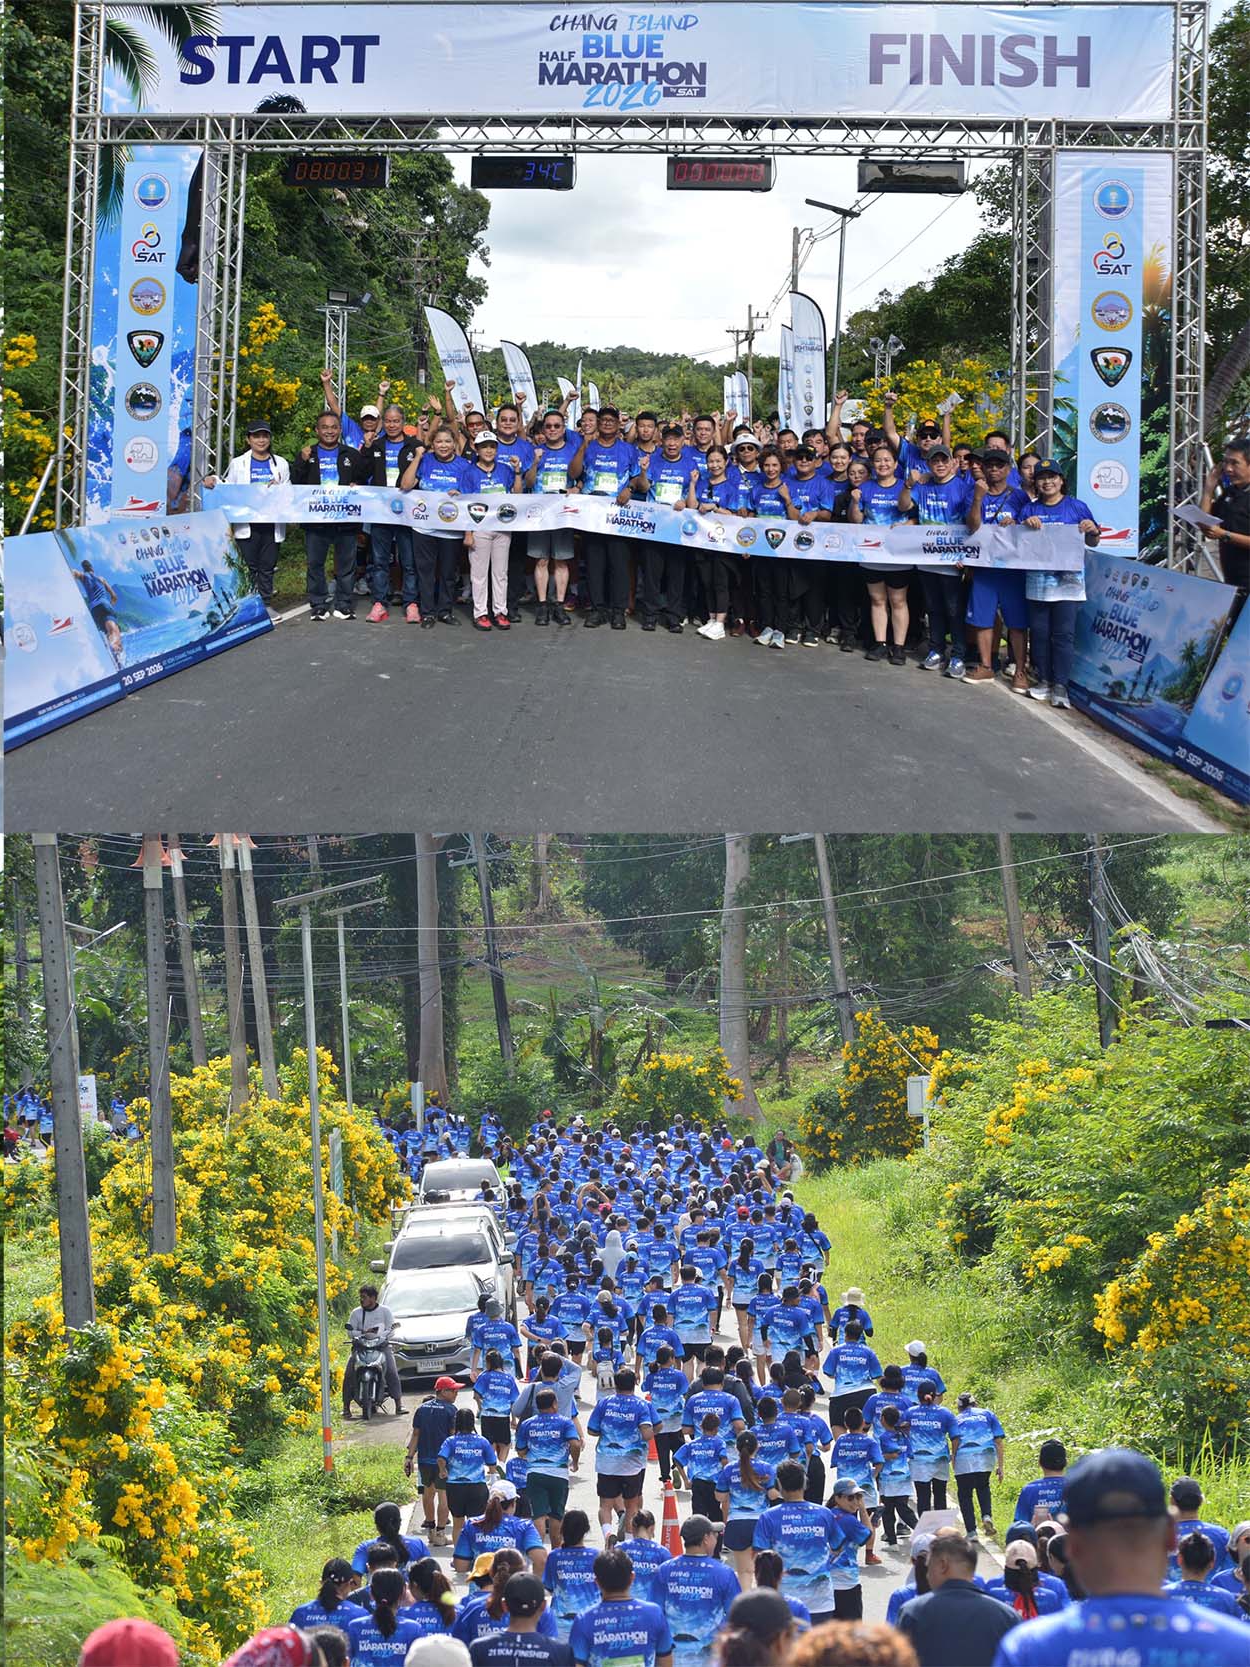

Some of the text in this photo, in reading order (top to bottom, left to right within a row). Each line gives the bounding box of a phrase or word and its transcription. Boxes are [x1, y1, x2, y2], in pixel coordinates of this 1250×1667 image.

[550, 14, 699, 31] CHANG ISLAND
[582, 34, 664, 59] BLUE
[180, 35, 380, 86] START
[539, 51, 576, 62] HALF
[869, 33, 1092, 88] FINISH
[538, 62, 707, 86] MARATHON
[582, 80, 661, 112] 2026
[676, 88, 700, 97] SAT
[135, 252, 166, 262] SAT
[1097, 264, 1132, 275] SAT
[309, 504, 361, 513] MARATHON
[619, 509, 645, 520] BLUE
[606, 515, 656, 531] MARATHON
[936, 536, 964, 545] BLUE
[136, 545, 164, 560] CHANG
[923, 546, 980, 554] MARATHON
[156, 555, 188, 575] BLUE
[144, 568, 209, 598] MARATHON
[1110, 603, 1141, 628] BLUE
[1092, 616, 1152, 655] MARATHON
[122, 675, 133, 686] 20
[133, 670, 146, 682] SEP
[147, 662, 164, 677] 2026
[1175, 746, 1187, 759] 20
[1186, 752, 1203, 768] SEP
[1201, 762, 1225, 782] 2026
[782, 1525, 825, 1535] MARATHON
[668, 1585, 713, 1597] MARATHON
[593, 1632, 648, 1645] MARATHON
[359, 1641, 407, 1652] MARATHON
[513, 1649, 550, 1660] FINISHER
